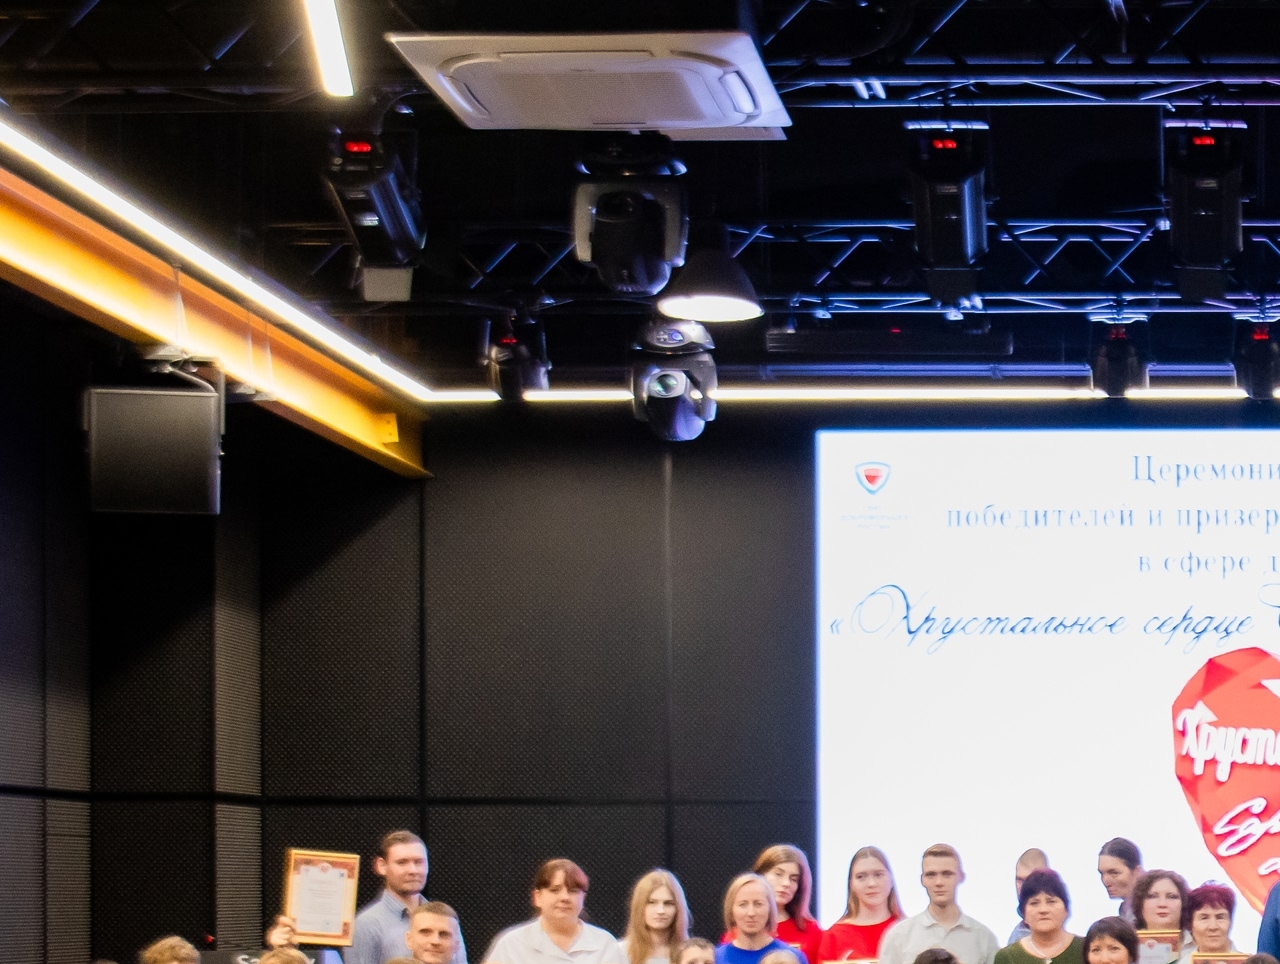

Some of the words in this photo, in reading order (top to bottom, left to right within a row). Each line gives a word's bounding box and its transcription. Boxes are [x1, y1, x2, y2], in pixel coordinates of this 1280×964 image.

[947, 503, 1134, 528] победителей
[1148, 508, 1162, 527] и
[1138, 555, 1151, 573] в
[1163, 550, 1251, 580] сфере
[1142, 604, 1257, 656] сердце
